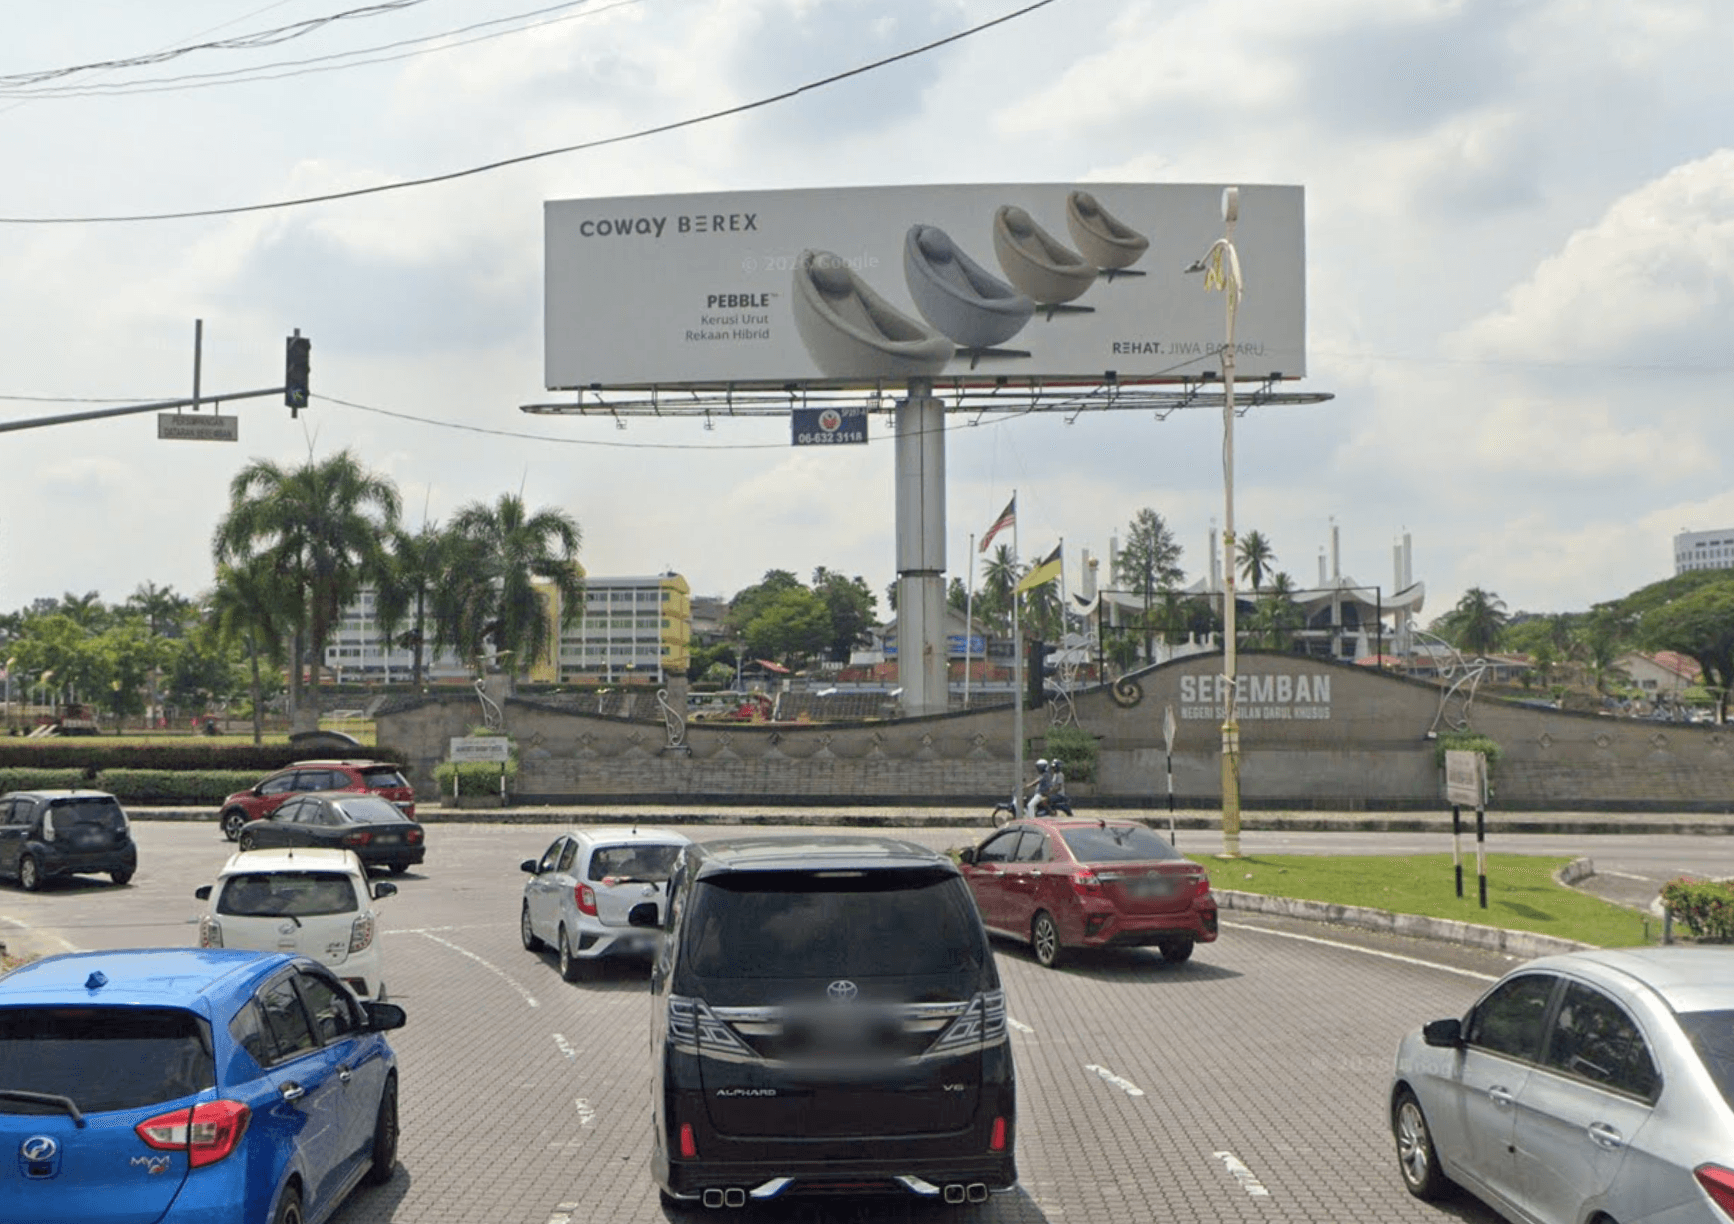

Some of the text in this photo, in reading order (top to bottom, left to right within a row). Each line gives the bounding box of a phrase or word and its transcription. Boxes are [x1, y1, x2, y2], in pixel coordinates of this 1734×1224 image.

[579, 213, 757, 238] coway BEREX
[701, 313, 769, 325] Kerusi Urut
[685, 327, 769, 341] Rekaan Hibrid
[1168, 342, 1202, 355] JIWA
[798, 432, 834, 444] 06-632
[716, 1083, 965, 1097] ALPHARD V6
